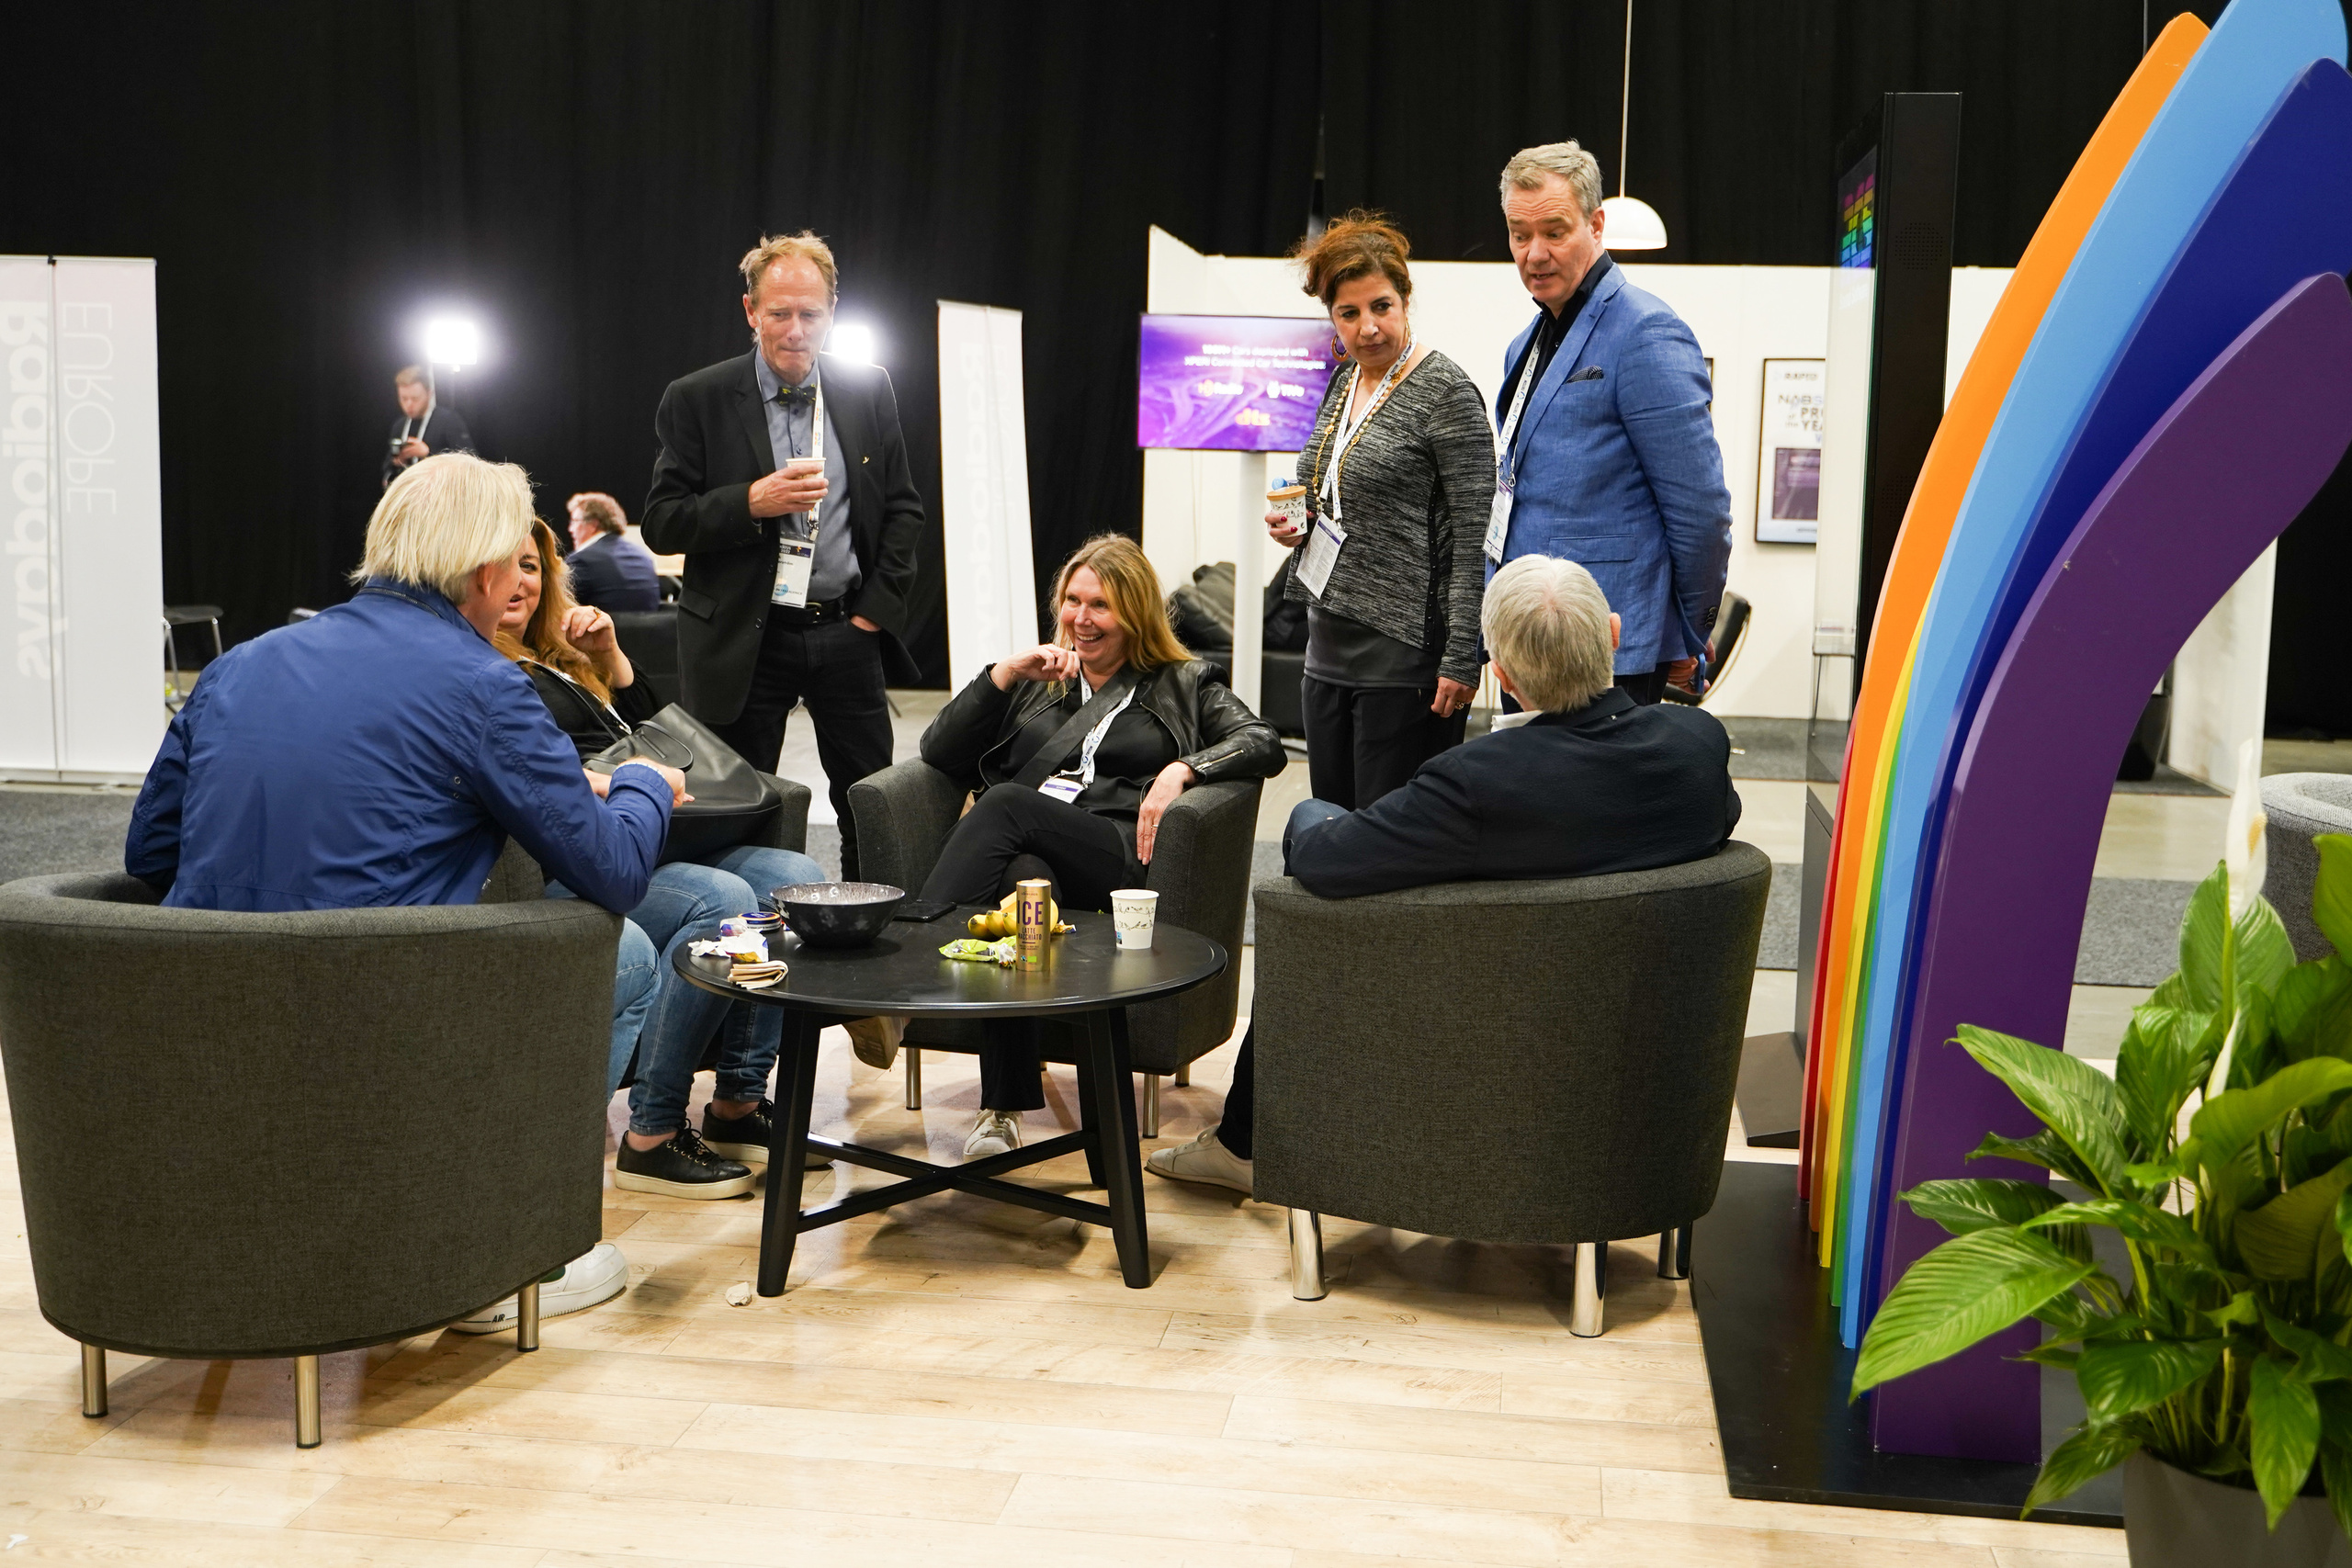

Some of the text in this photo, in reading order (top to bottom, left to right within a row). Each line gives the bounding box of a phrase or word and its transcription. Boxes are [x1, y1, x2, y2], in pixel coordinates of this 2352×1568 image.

[1801, 407, 1823, 419] PR
[1017, 900, 1044, 925] ICE
[492, 1314, 505, 1323] AIR
